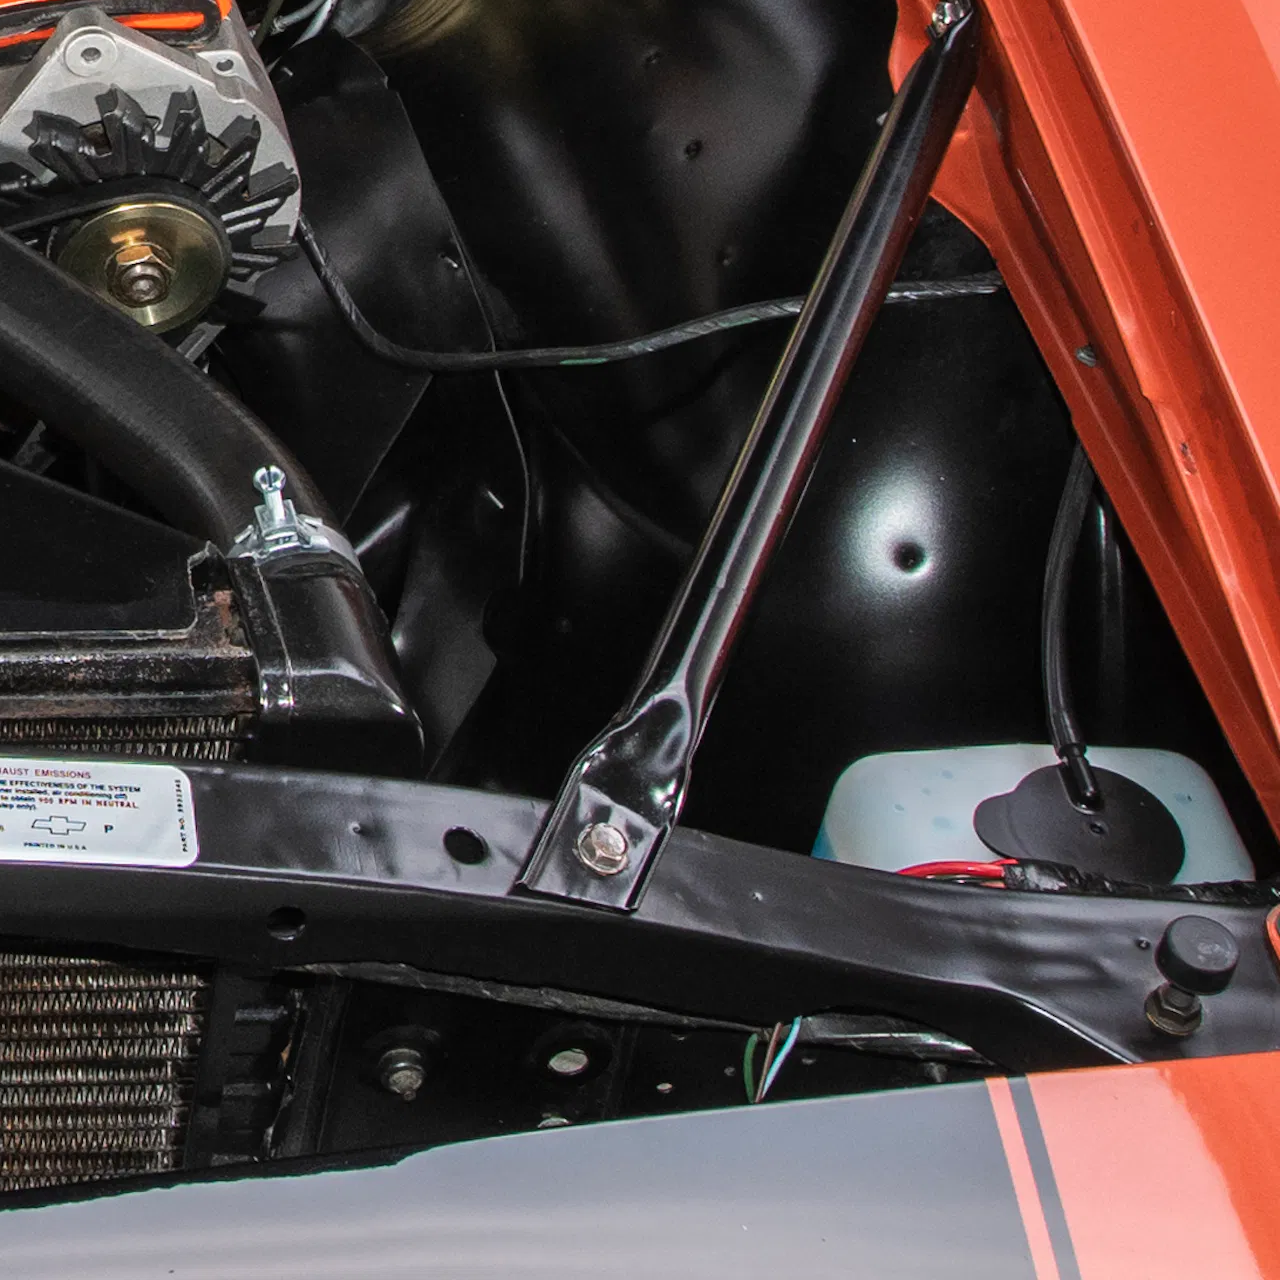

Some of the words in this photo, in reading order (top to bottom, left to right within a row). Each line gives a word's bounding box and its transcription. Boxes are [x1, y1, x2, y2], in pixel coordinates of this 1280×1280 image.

[34, 769, 91, 778] EMISSIONS
[9, 780, 74, 789] EFFECTIVENESS
[104, 824, 113, 833] P
